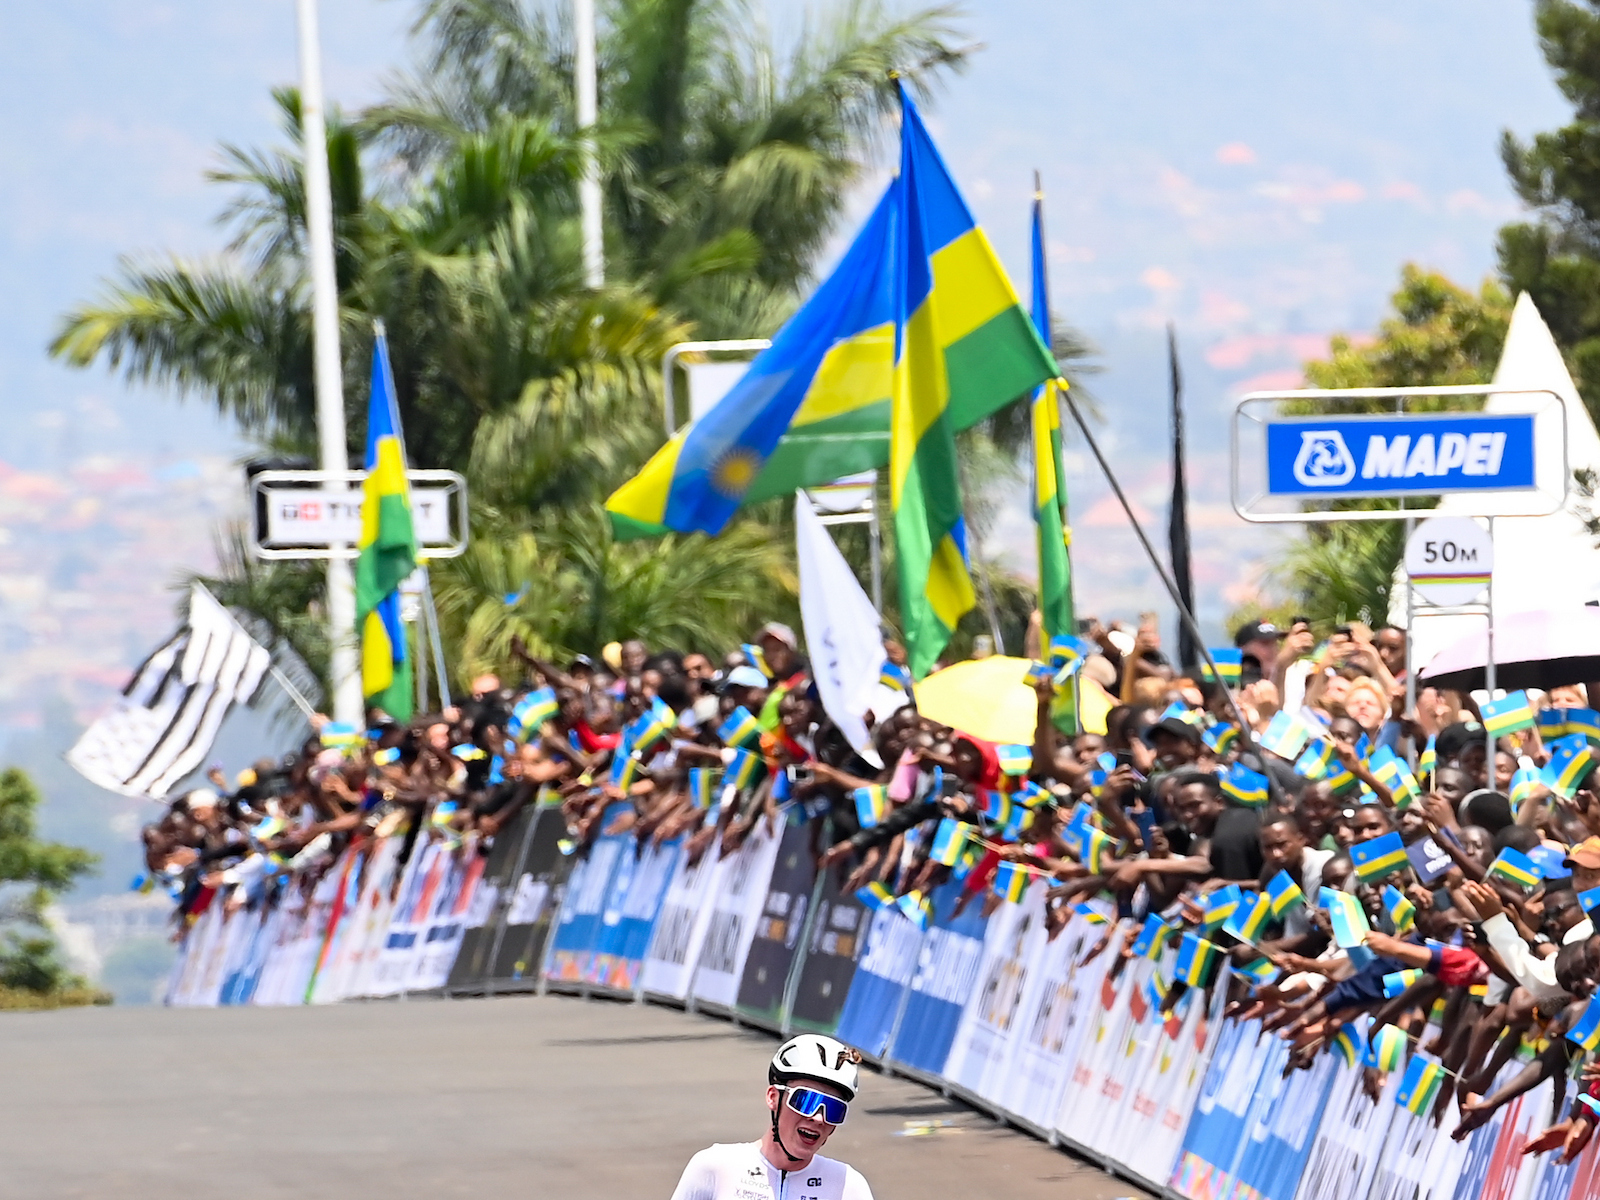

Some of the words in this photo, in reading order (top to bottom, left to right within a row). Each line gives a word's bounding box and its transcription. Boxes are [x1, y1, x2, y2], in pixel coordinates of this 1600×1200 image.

[1361, 431, 1507, 479] MAPEI
[1423, 541, 1478, 564] 50M
[740, 1178, 769, 1190] LLOYDS
